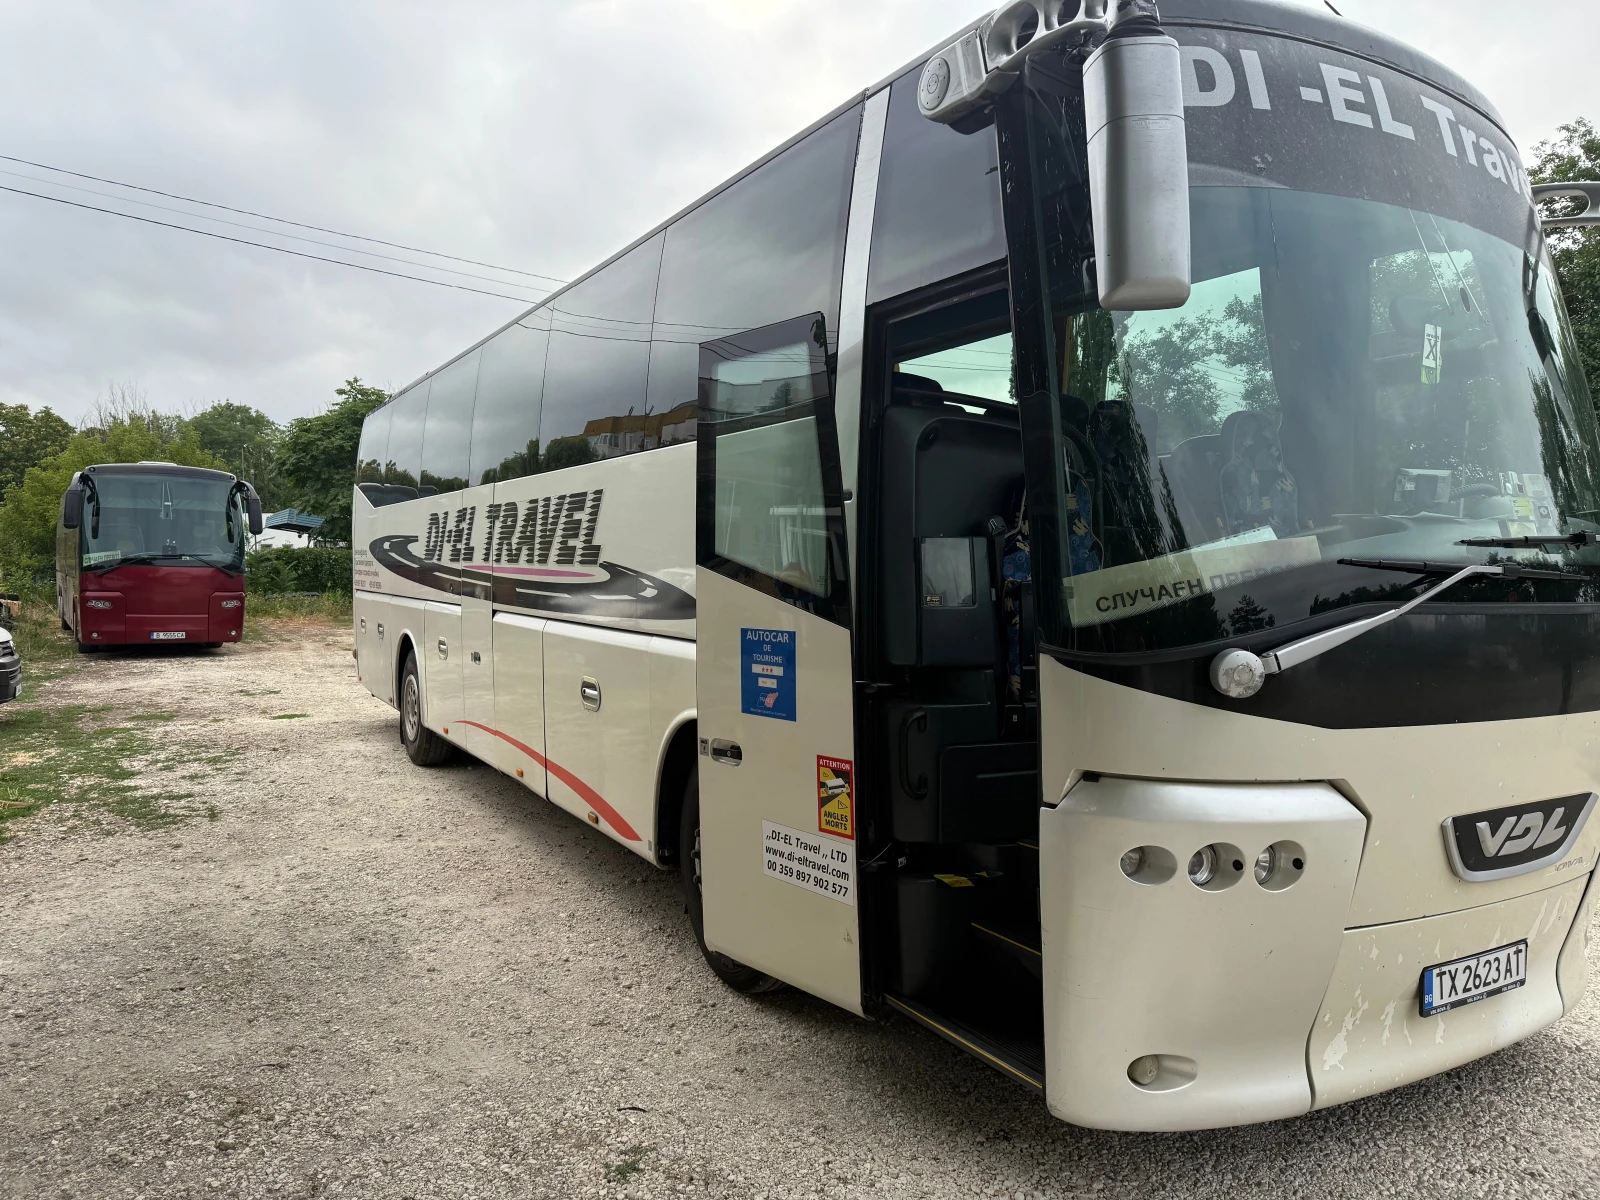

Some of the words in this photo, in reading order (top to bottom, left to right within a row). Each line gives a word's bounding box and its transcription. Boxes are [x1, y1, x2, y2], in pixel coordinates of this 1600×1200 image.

[1182, 45, 1272, 111] DI
[423, 505, 477, 563] DI-EL
[481, 488, 604, 566] TRAVEL
[746, 630, 789, 643] AUTOCAR
[763, 644, 772, 652] DE
[752, 653, 783, 664] TOURISME
[819, 758, 851, 771] ATTENTION
[823, 809, 849, 823] ANGLES
[824, 818, 848, 831] MORTS
[1475, 806, 1567, 858] VDL
[795, 837, 821, 855] Travel
[830, 848, 848, 864] LTD
[765, 845, 850, 882] www.di-eltravel.com
[767, 859, 777, 872] 00
[778, 863, 794, 878] 359
[795, 869, 812, 884] 897
[813, 875, 829, 891] 902
[831, 882, 849, 898] 577
[1435, 966, 1459, 1001] TX
[1462, 956, 1501, 994] 2623
[1503, 947, 1523, 981] AT
[1424, 993, 1433, 1004] BG
